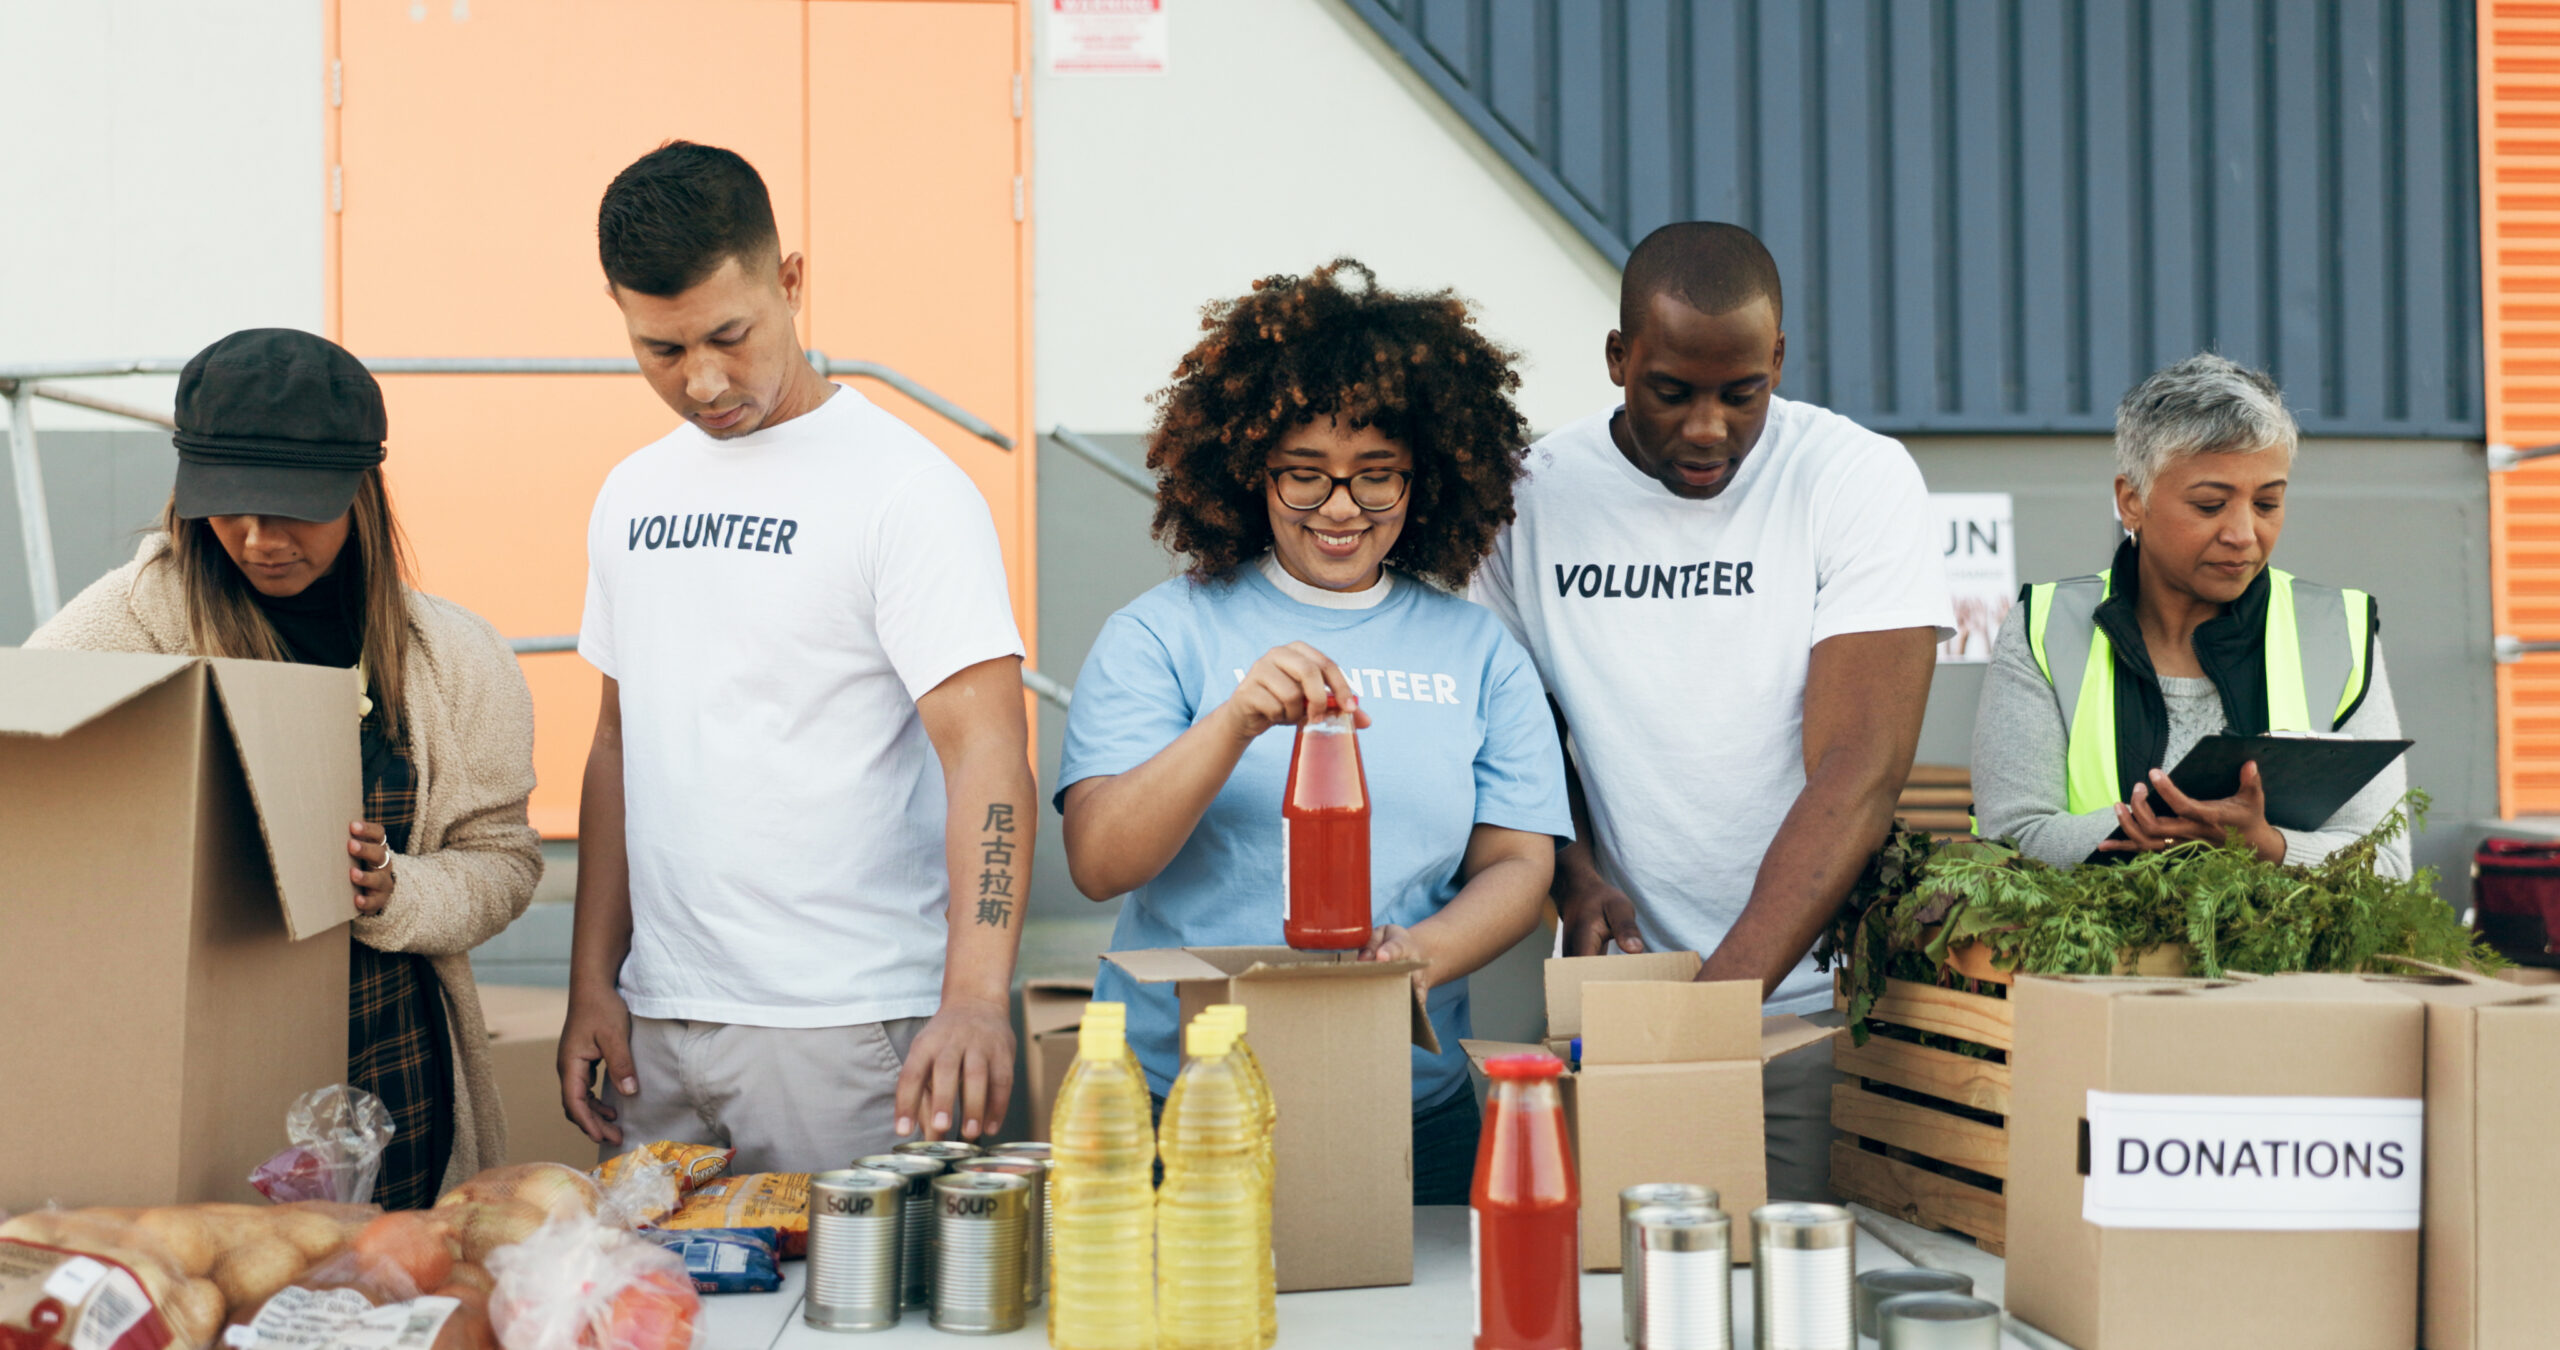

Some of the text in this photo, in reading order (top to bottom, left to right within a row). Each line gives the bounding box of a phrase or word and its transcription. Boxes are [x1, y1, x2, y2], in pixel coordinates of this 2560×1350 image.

[628, 513, 798, 555] VOLUNTEER
[1555, 560, 1755, 599] VOLUNTEER
[1233, 668, 1461, 705] NTEER
[975, 803, 1016, 929] 尼古拉斯
[2117, 1137, 2405, 1179] DONATIONS
[827, 1196, 874, 1215] SOUP
[945, 1195, 998, 1217] SOUP
